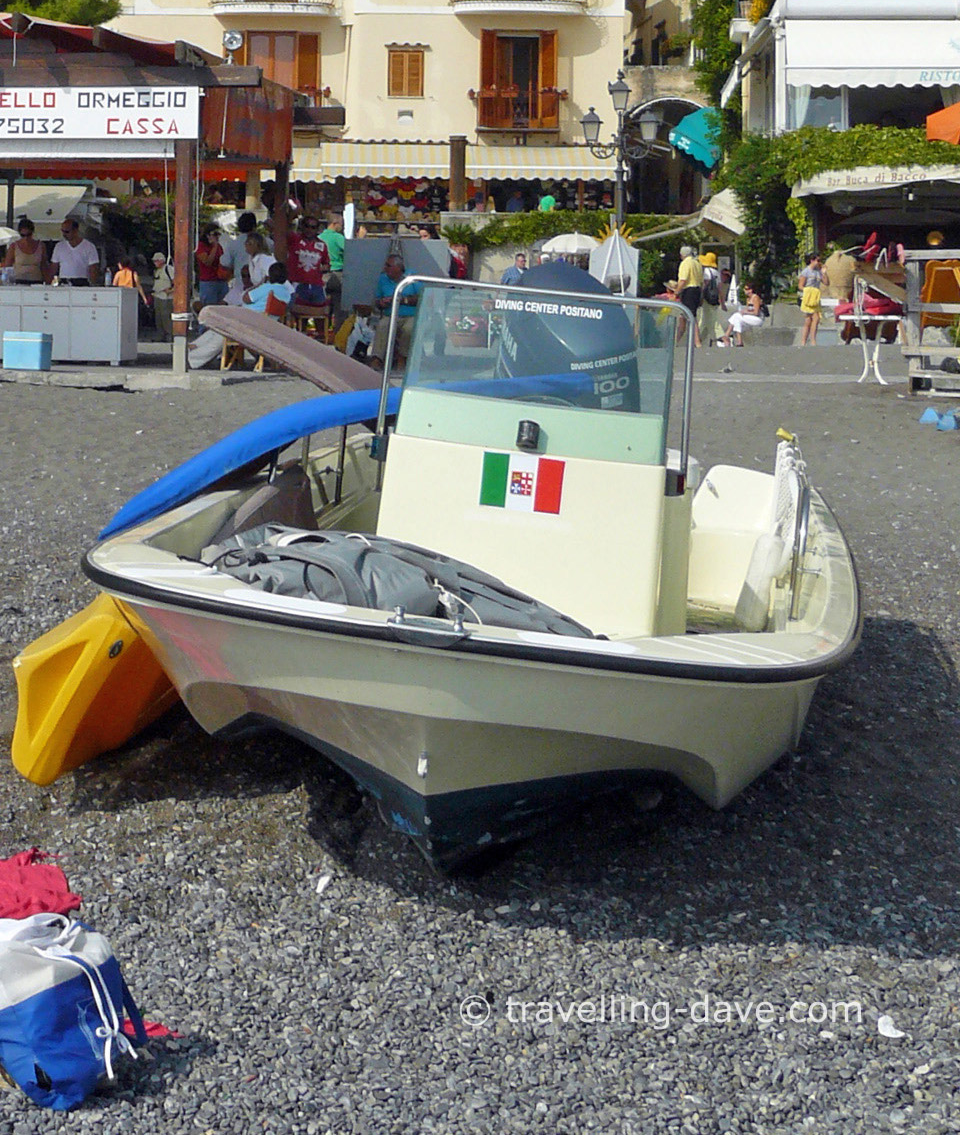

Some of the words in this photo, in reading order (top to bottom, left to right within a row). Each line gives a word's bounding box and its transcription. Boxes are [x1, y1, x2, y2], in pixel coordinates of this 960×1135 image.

[78, 91, 187, 108] ORMEGGIO
[106, 118, 179, 134] CASSA
[845, 175, 868, 186] Buca
[875, 172, 885, 183] di
[891, 172, 927, 182] Bacco
[495, 299, 524, 311] DIVING
[525, 301, 558, 315] CENTER
[560, 305, 603, 319] POSITANO
[594, 356, 618, 368] CENTER
[594, 376, 630, 395] 100
